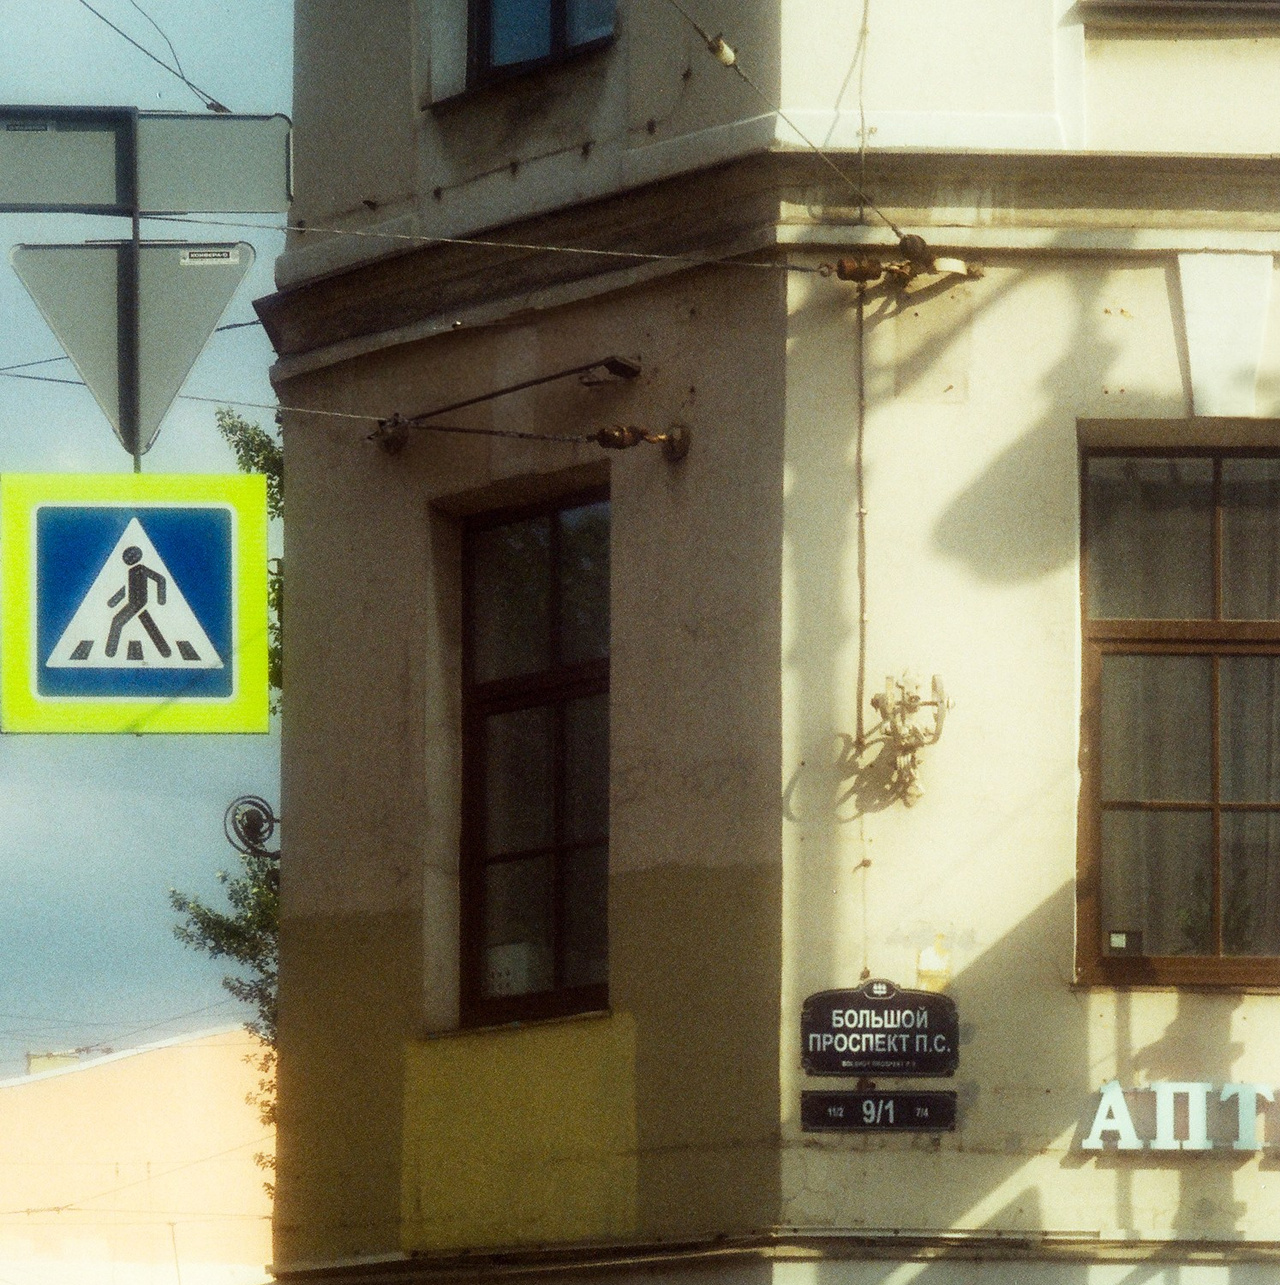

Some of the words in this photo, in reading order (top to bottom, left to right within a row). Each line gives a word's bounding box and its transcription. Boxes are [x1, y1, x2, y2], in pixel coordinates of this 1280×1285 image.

[831, 1006, 928, 1029] БОЛЬШОЙ
[808, 1033, 909, 1052] ПРОСПЕКТ
[915, 1033, 951, 1052] П.С.
[862, 1100, 894, 1124] 9/1
